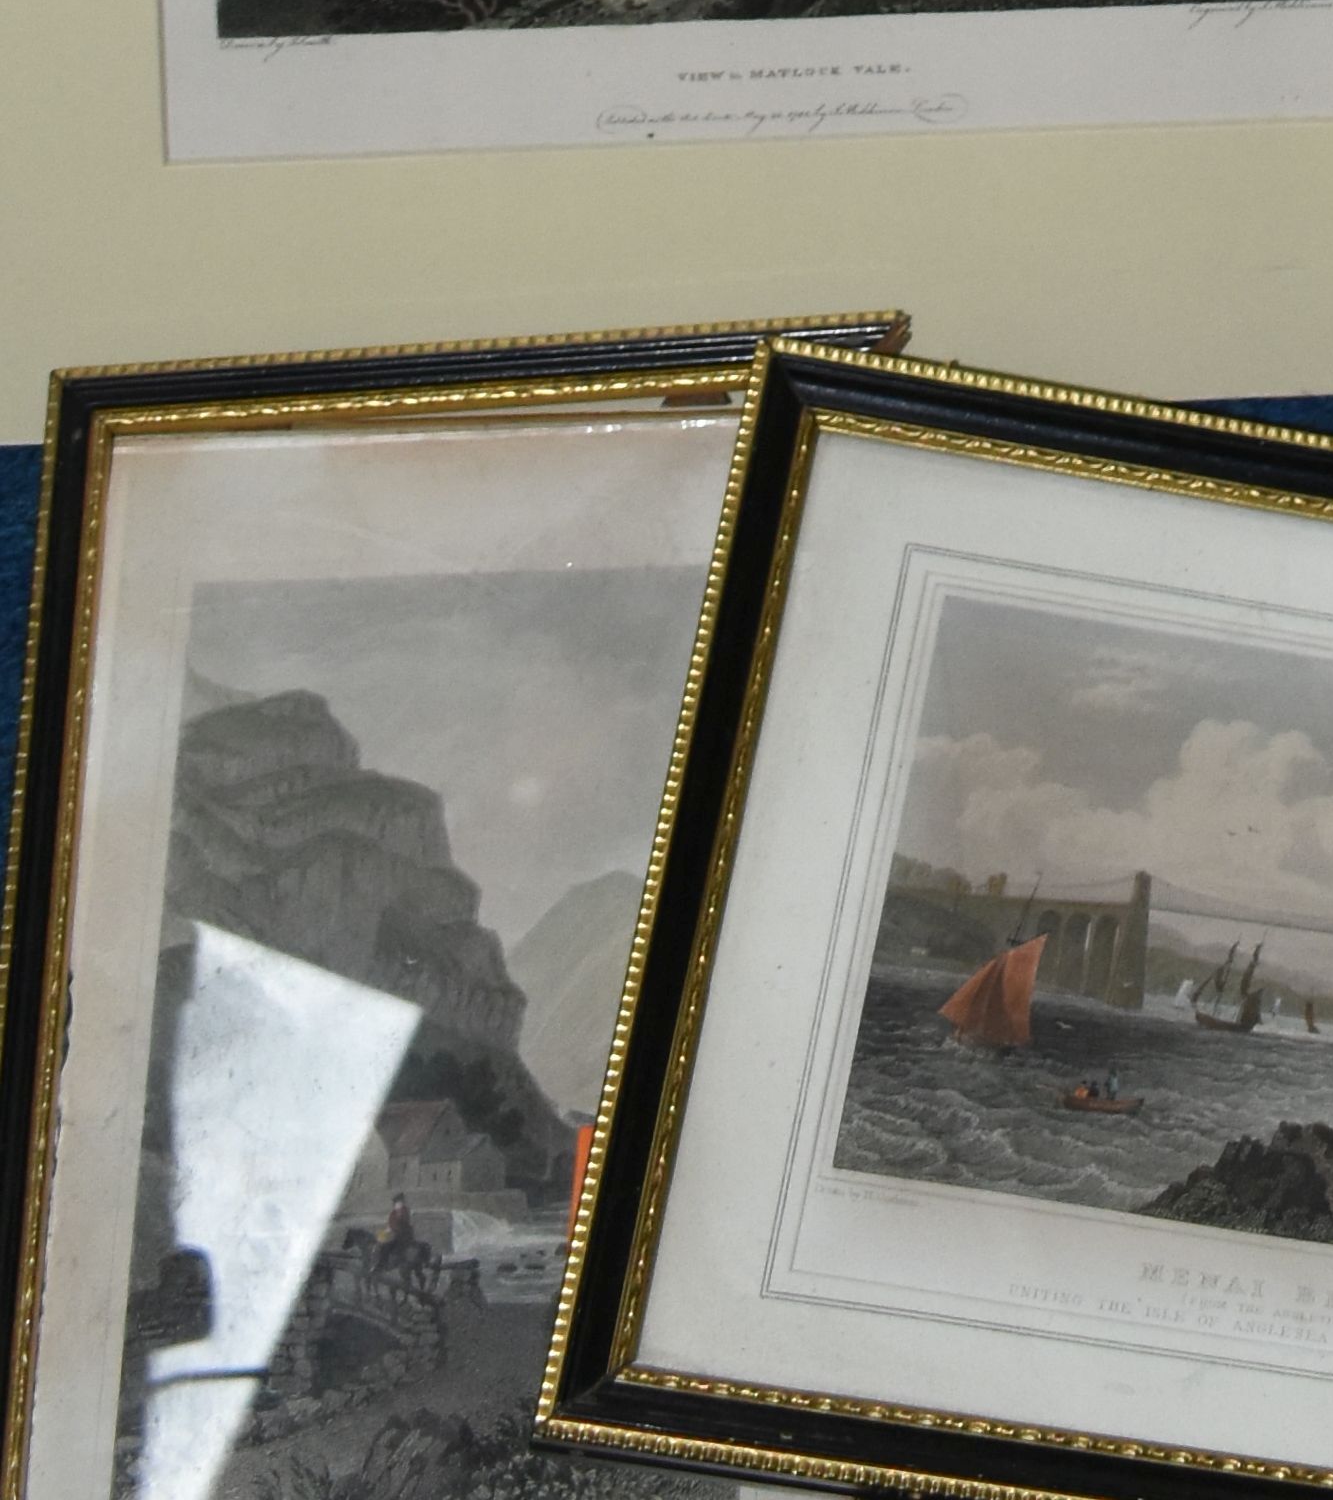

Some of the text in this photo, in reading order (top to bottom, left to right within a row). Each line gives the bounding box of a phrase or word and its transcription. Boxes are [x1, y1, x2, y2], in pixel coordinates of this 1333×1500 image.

[678, 71, 724, 82] VIEW
[749, 67, 841, 79] MATLOCK
[1140, 1262, 1266, 1296] MENAI
[1008, 1283, 1084, 1308] UNITING
[1098, 1298, 1132, 1316] THE
[1143, 1305, 1187, 1324] ISLE
[1197, 1312, 1218, 1328] OF
[1232, 1317, 1329, 1345] ANGLESEA
